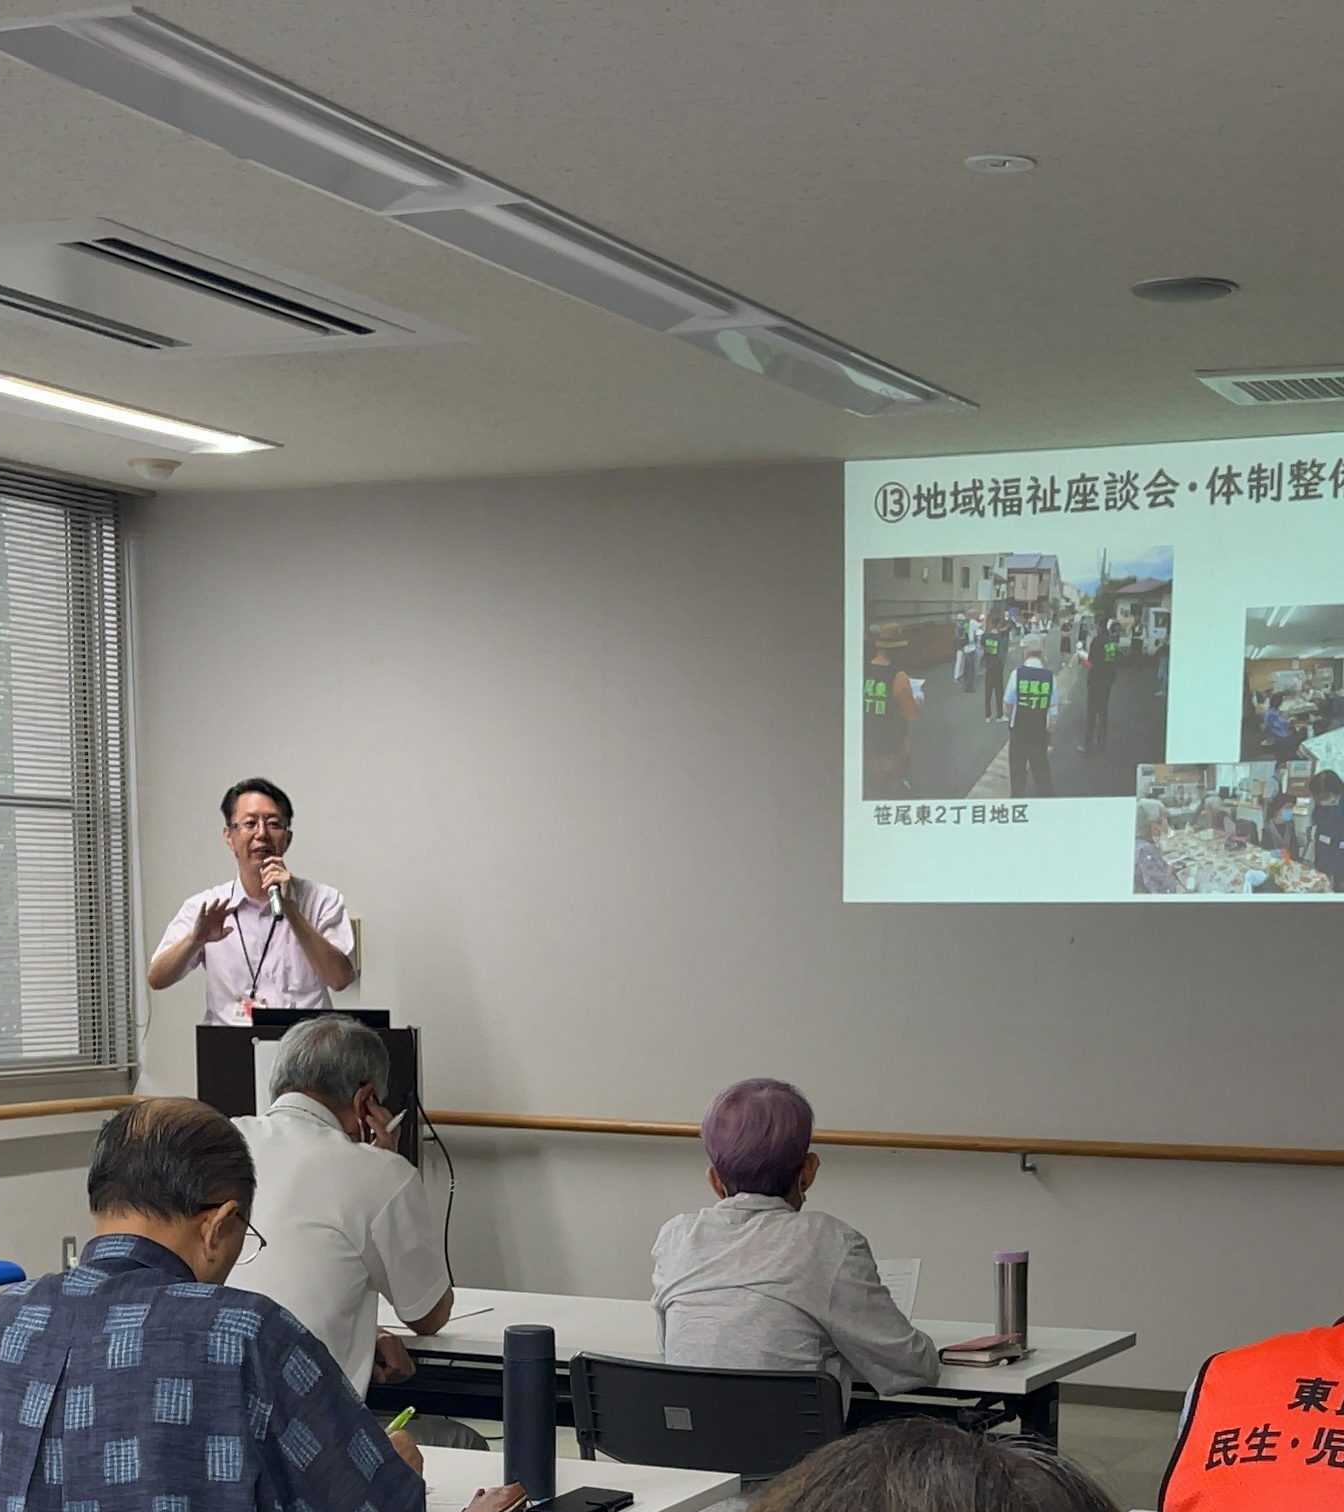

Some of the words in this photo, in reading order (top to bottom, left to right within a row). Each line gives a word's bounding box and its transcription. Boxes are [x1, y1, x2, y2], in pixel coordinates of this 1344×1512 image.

[873, 803, 1029, 825] 笹尾東2丁目地区
